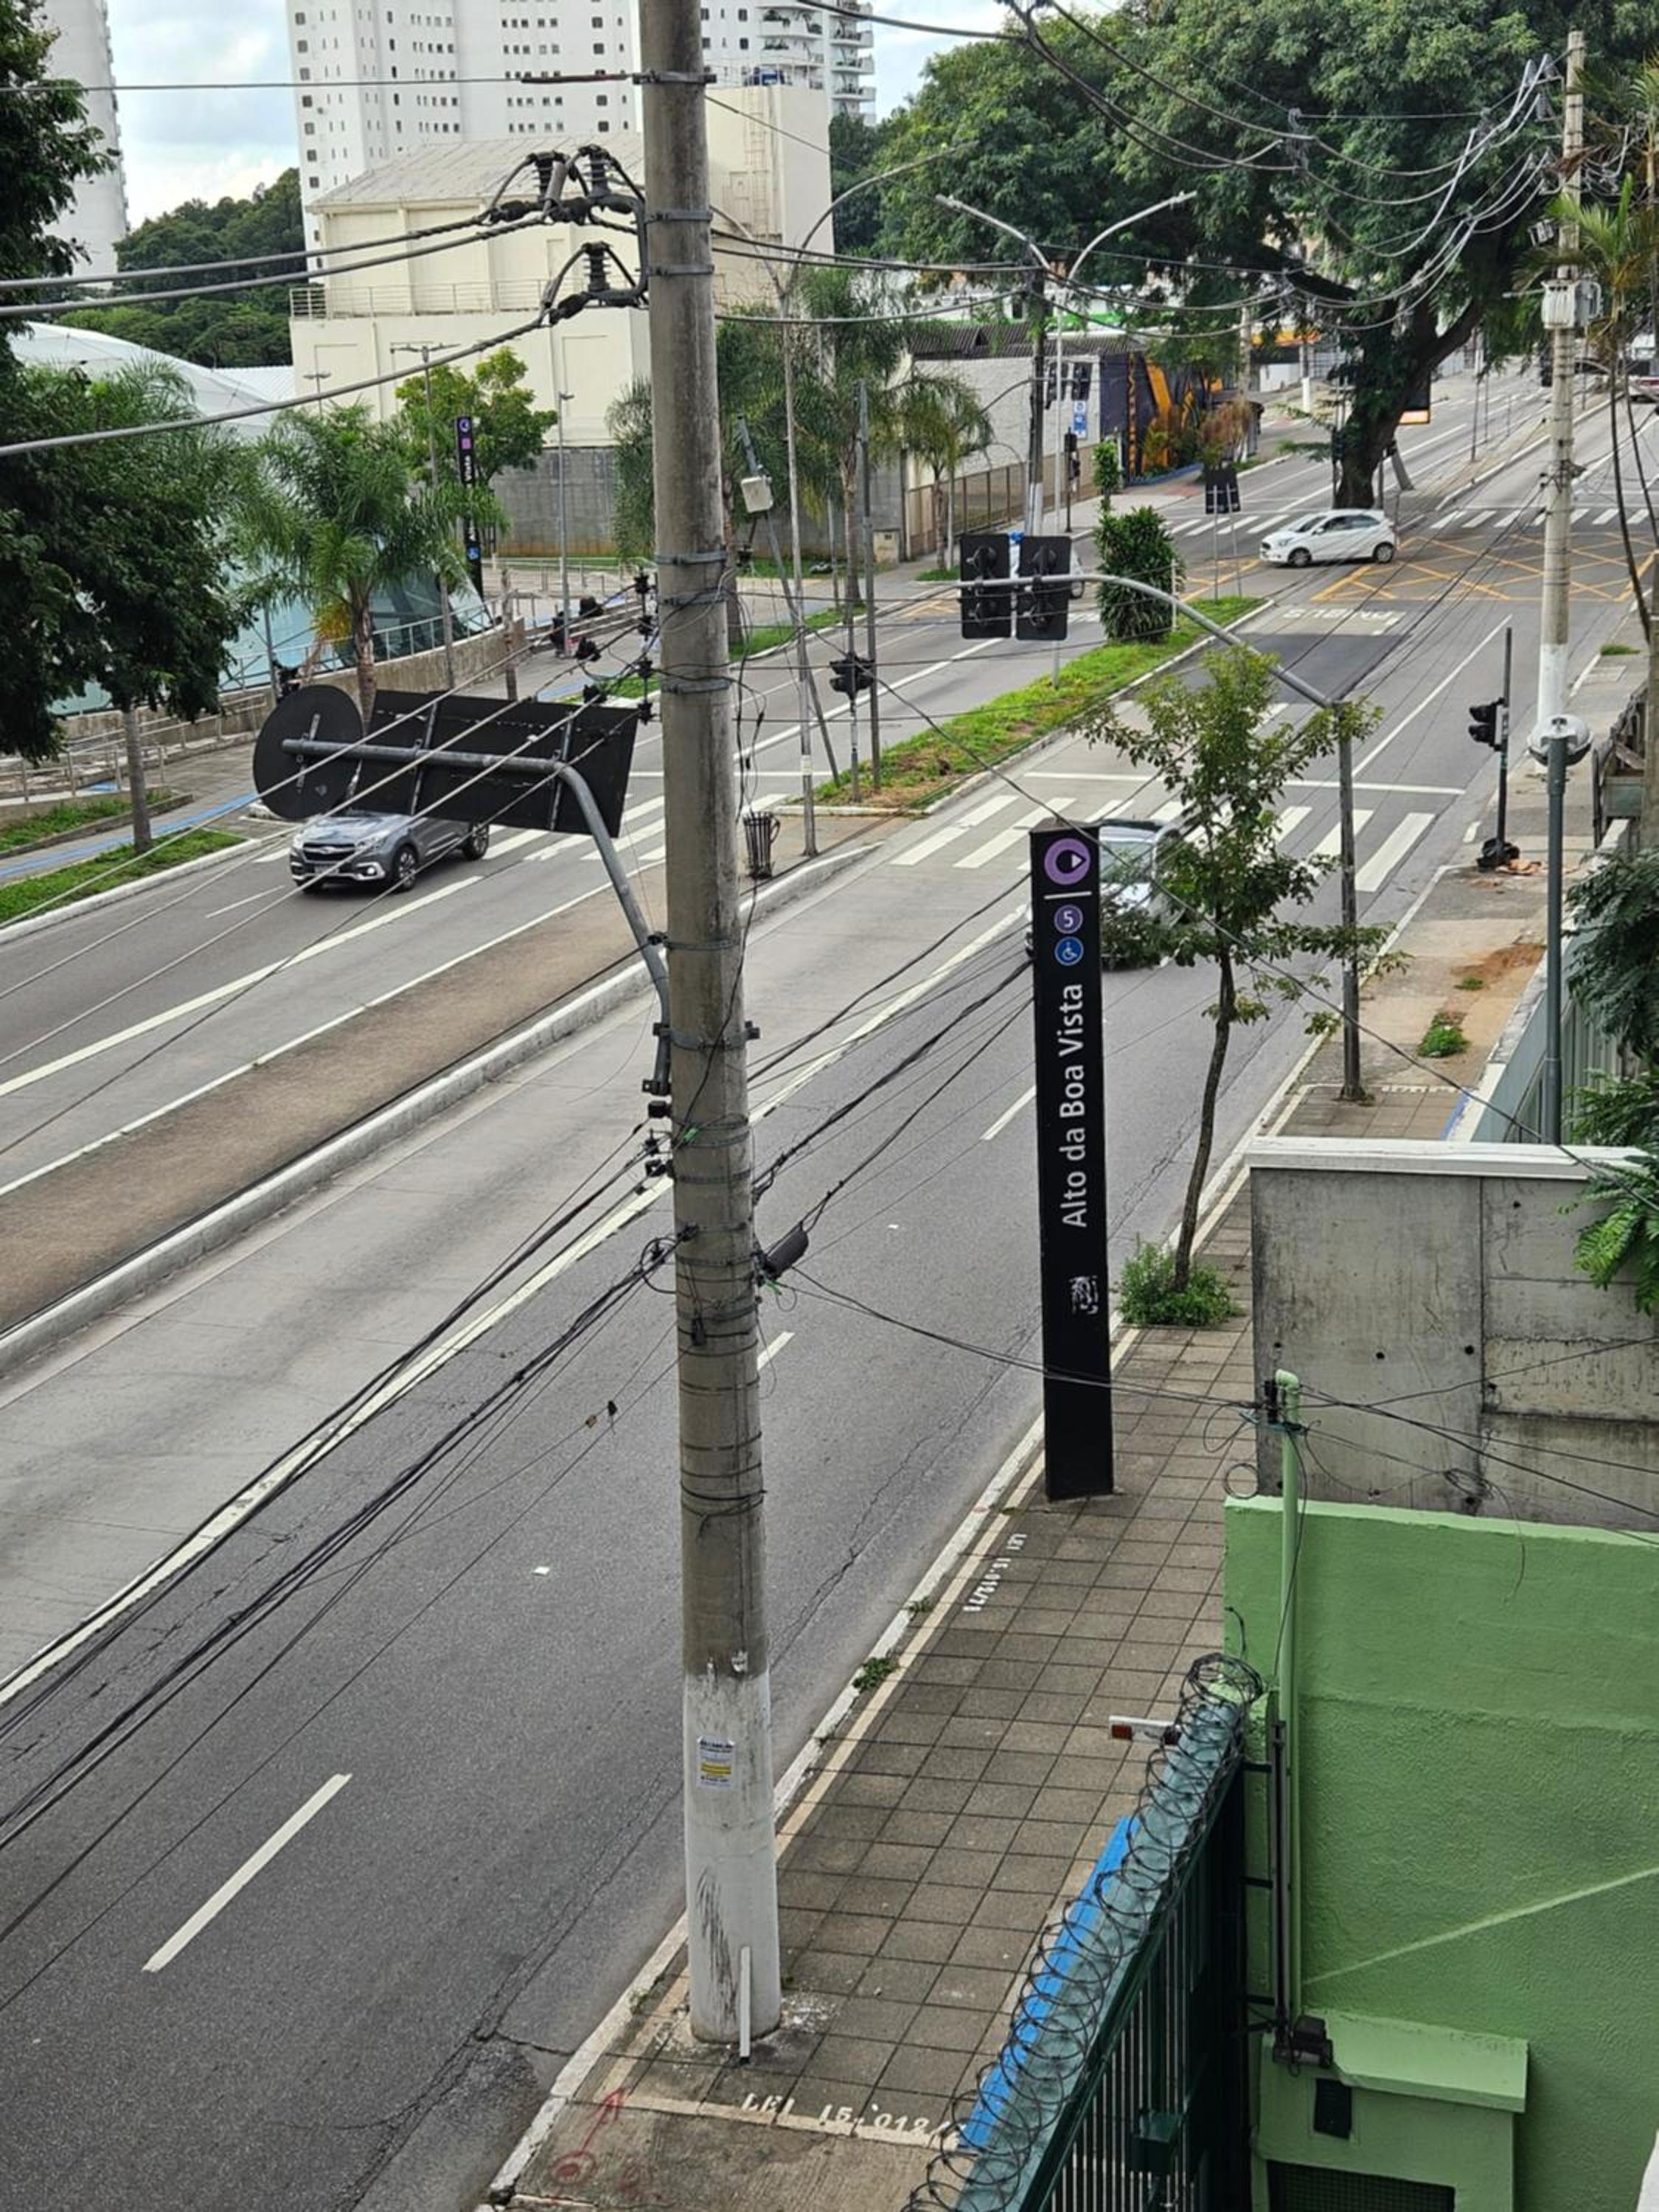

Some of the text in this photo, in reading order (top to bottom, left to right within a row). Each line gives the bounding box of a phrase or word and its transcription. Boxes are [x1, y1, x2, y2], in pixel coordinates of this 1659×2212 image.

[1063, 910, 1074, 928] 5
[1056, 984, 1087, 1228] Alto da Boa Vista
[1005, 1533, 1027, 1550] LEI
[741, 2093, 796, 2115] LEI
